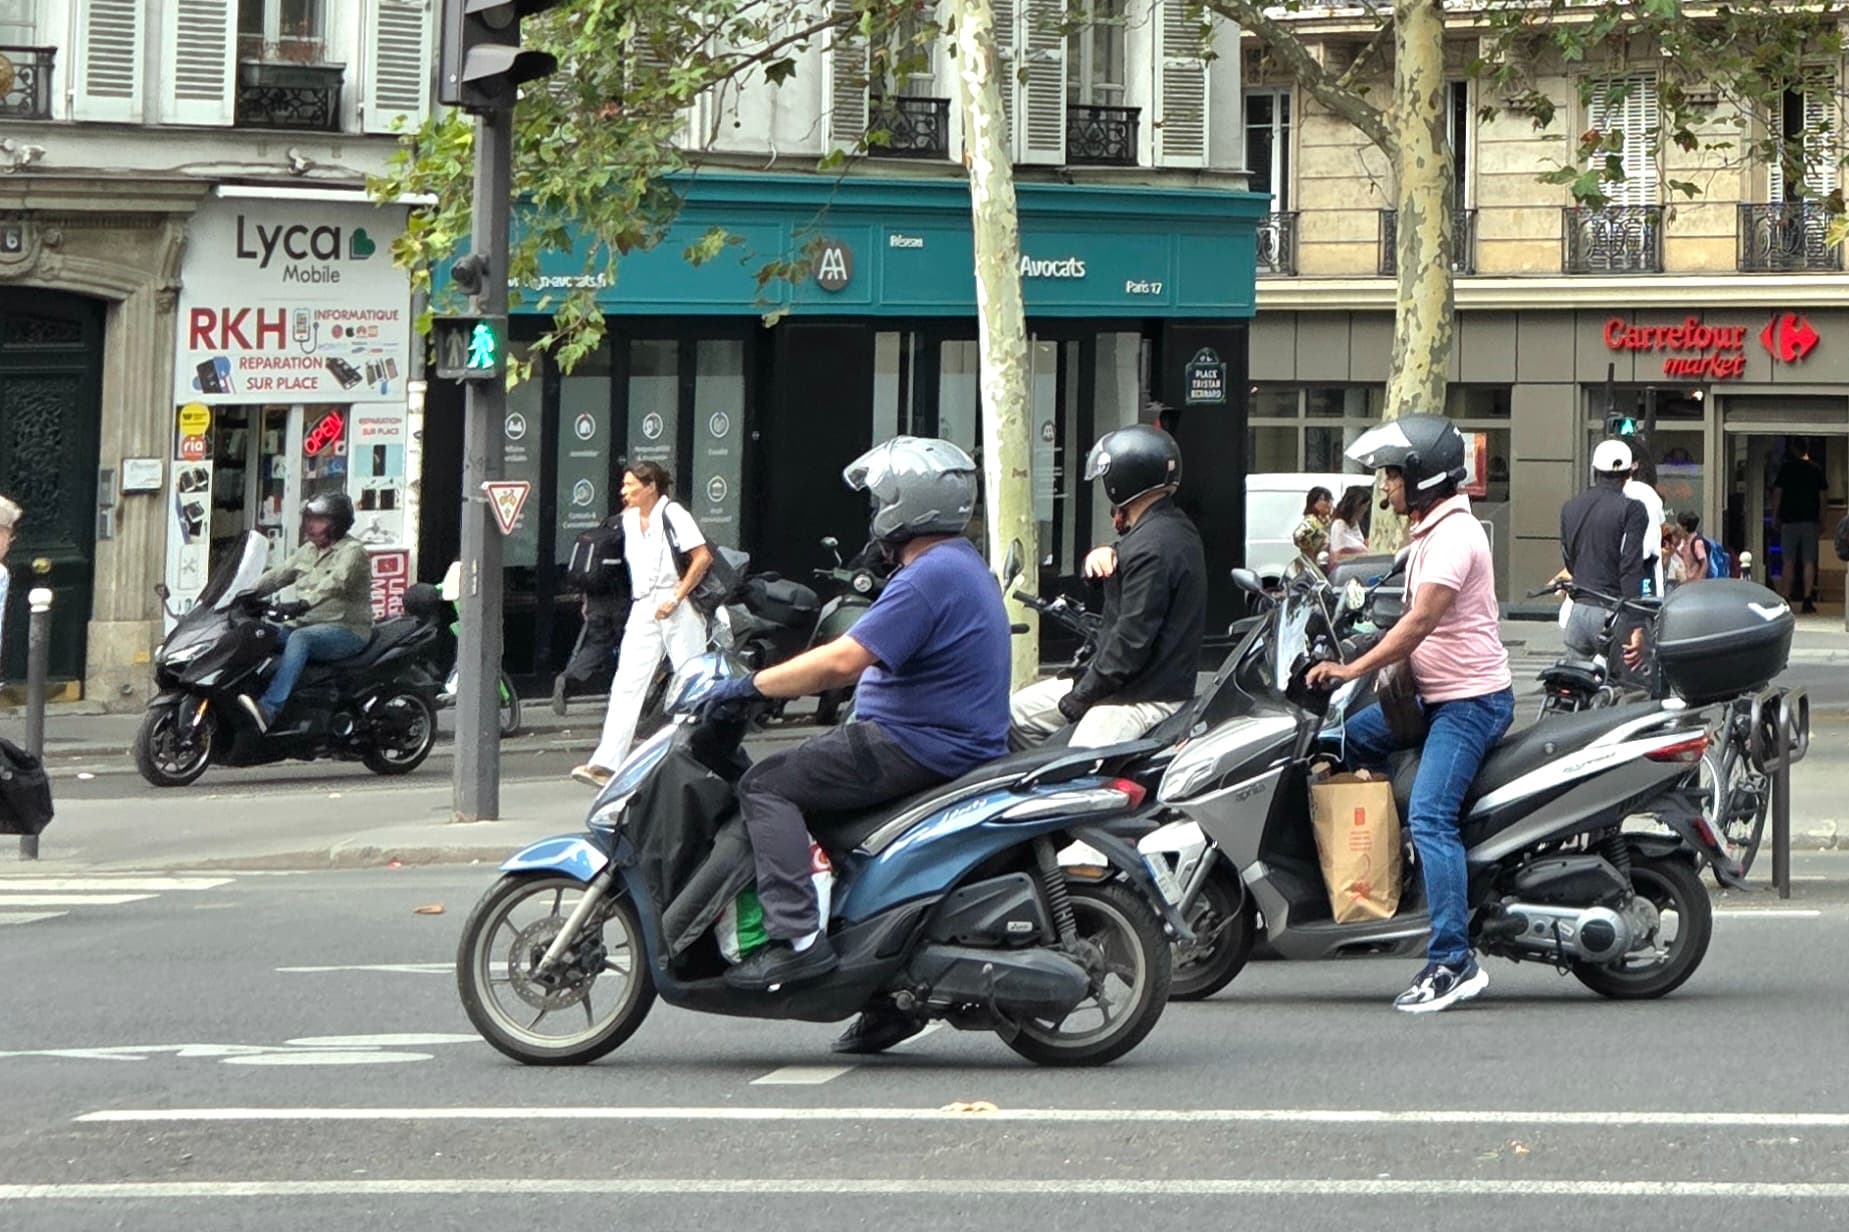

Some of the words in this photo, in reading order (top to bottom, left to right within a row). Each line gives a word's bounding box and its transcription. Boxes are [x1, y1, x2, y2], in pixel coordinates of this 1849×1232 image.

[236, 215, 341, 268] Lyca
[282, 265, 341, 283] Mobile
[1019, 255, 1086, 277] Avocats
[1126, 280, 1150, 294] Paris
[1151, 282, 1163, 295] 17
[314, 309, 399, 321] INFORMATIQUE
[189, 307, 287, 351] RKH
[1604, 317, 1746, 350] Carrefour
[239, 356, 323, 369] REPARATION
[1664, 353, 1746, 378] market
[1195, 369, 1218, 378] PLACE
[247, 377, 273, 390] SUR
[276, 377, 318, 390] PLACE
[304, 409, 345, 455] OPEN
[183, 436, 204, 453] ria
